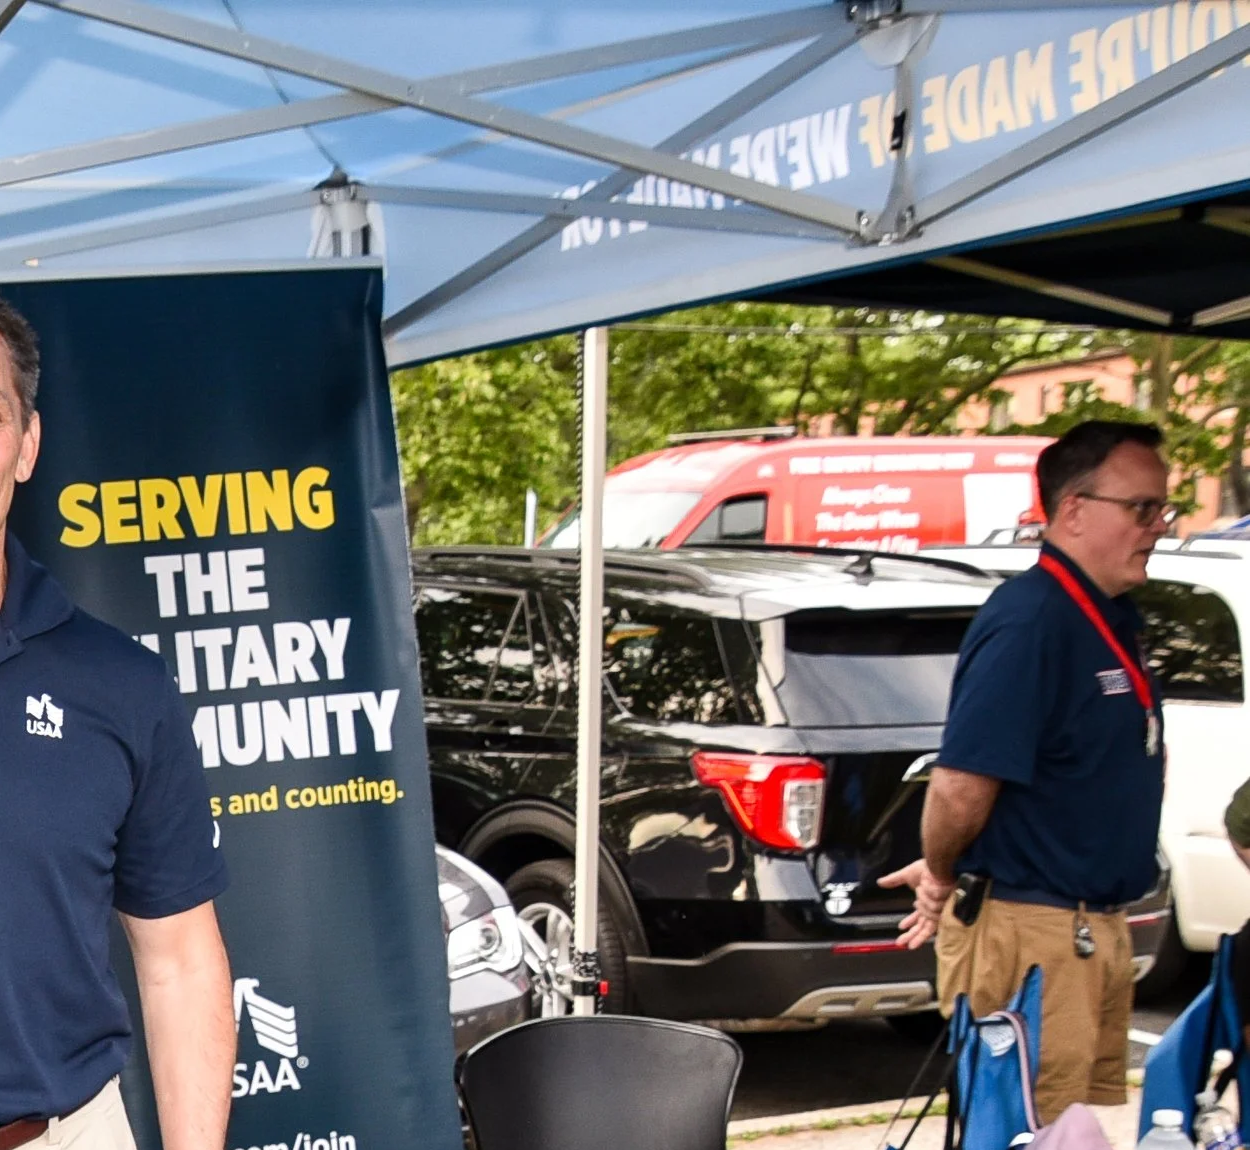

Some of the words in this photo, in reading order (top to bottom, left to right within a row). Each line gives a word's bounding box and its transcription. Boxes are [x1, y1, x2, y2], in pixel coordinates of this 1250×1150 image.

[58, 466, 335, 548] SERVING
[144, 548, 270, 618] THE
[134, 617, 351, 694] ITARY
[26, 719, 63, 740] USAA
[192, 689, 400, 768] MUNITY
[228, 784, 279, 815] and
[285, 776, 404, 810] counting.
